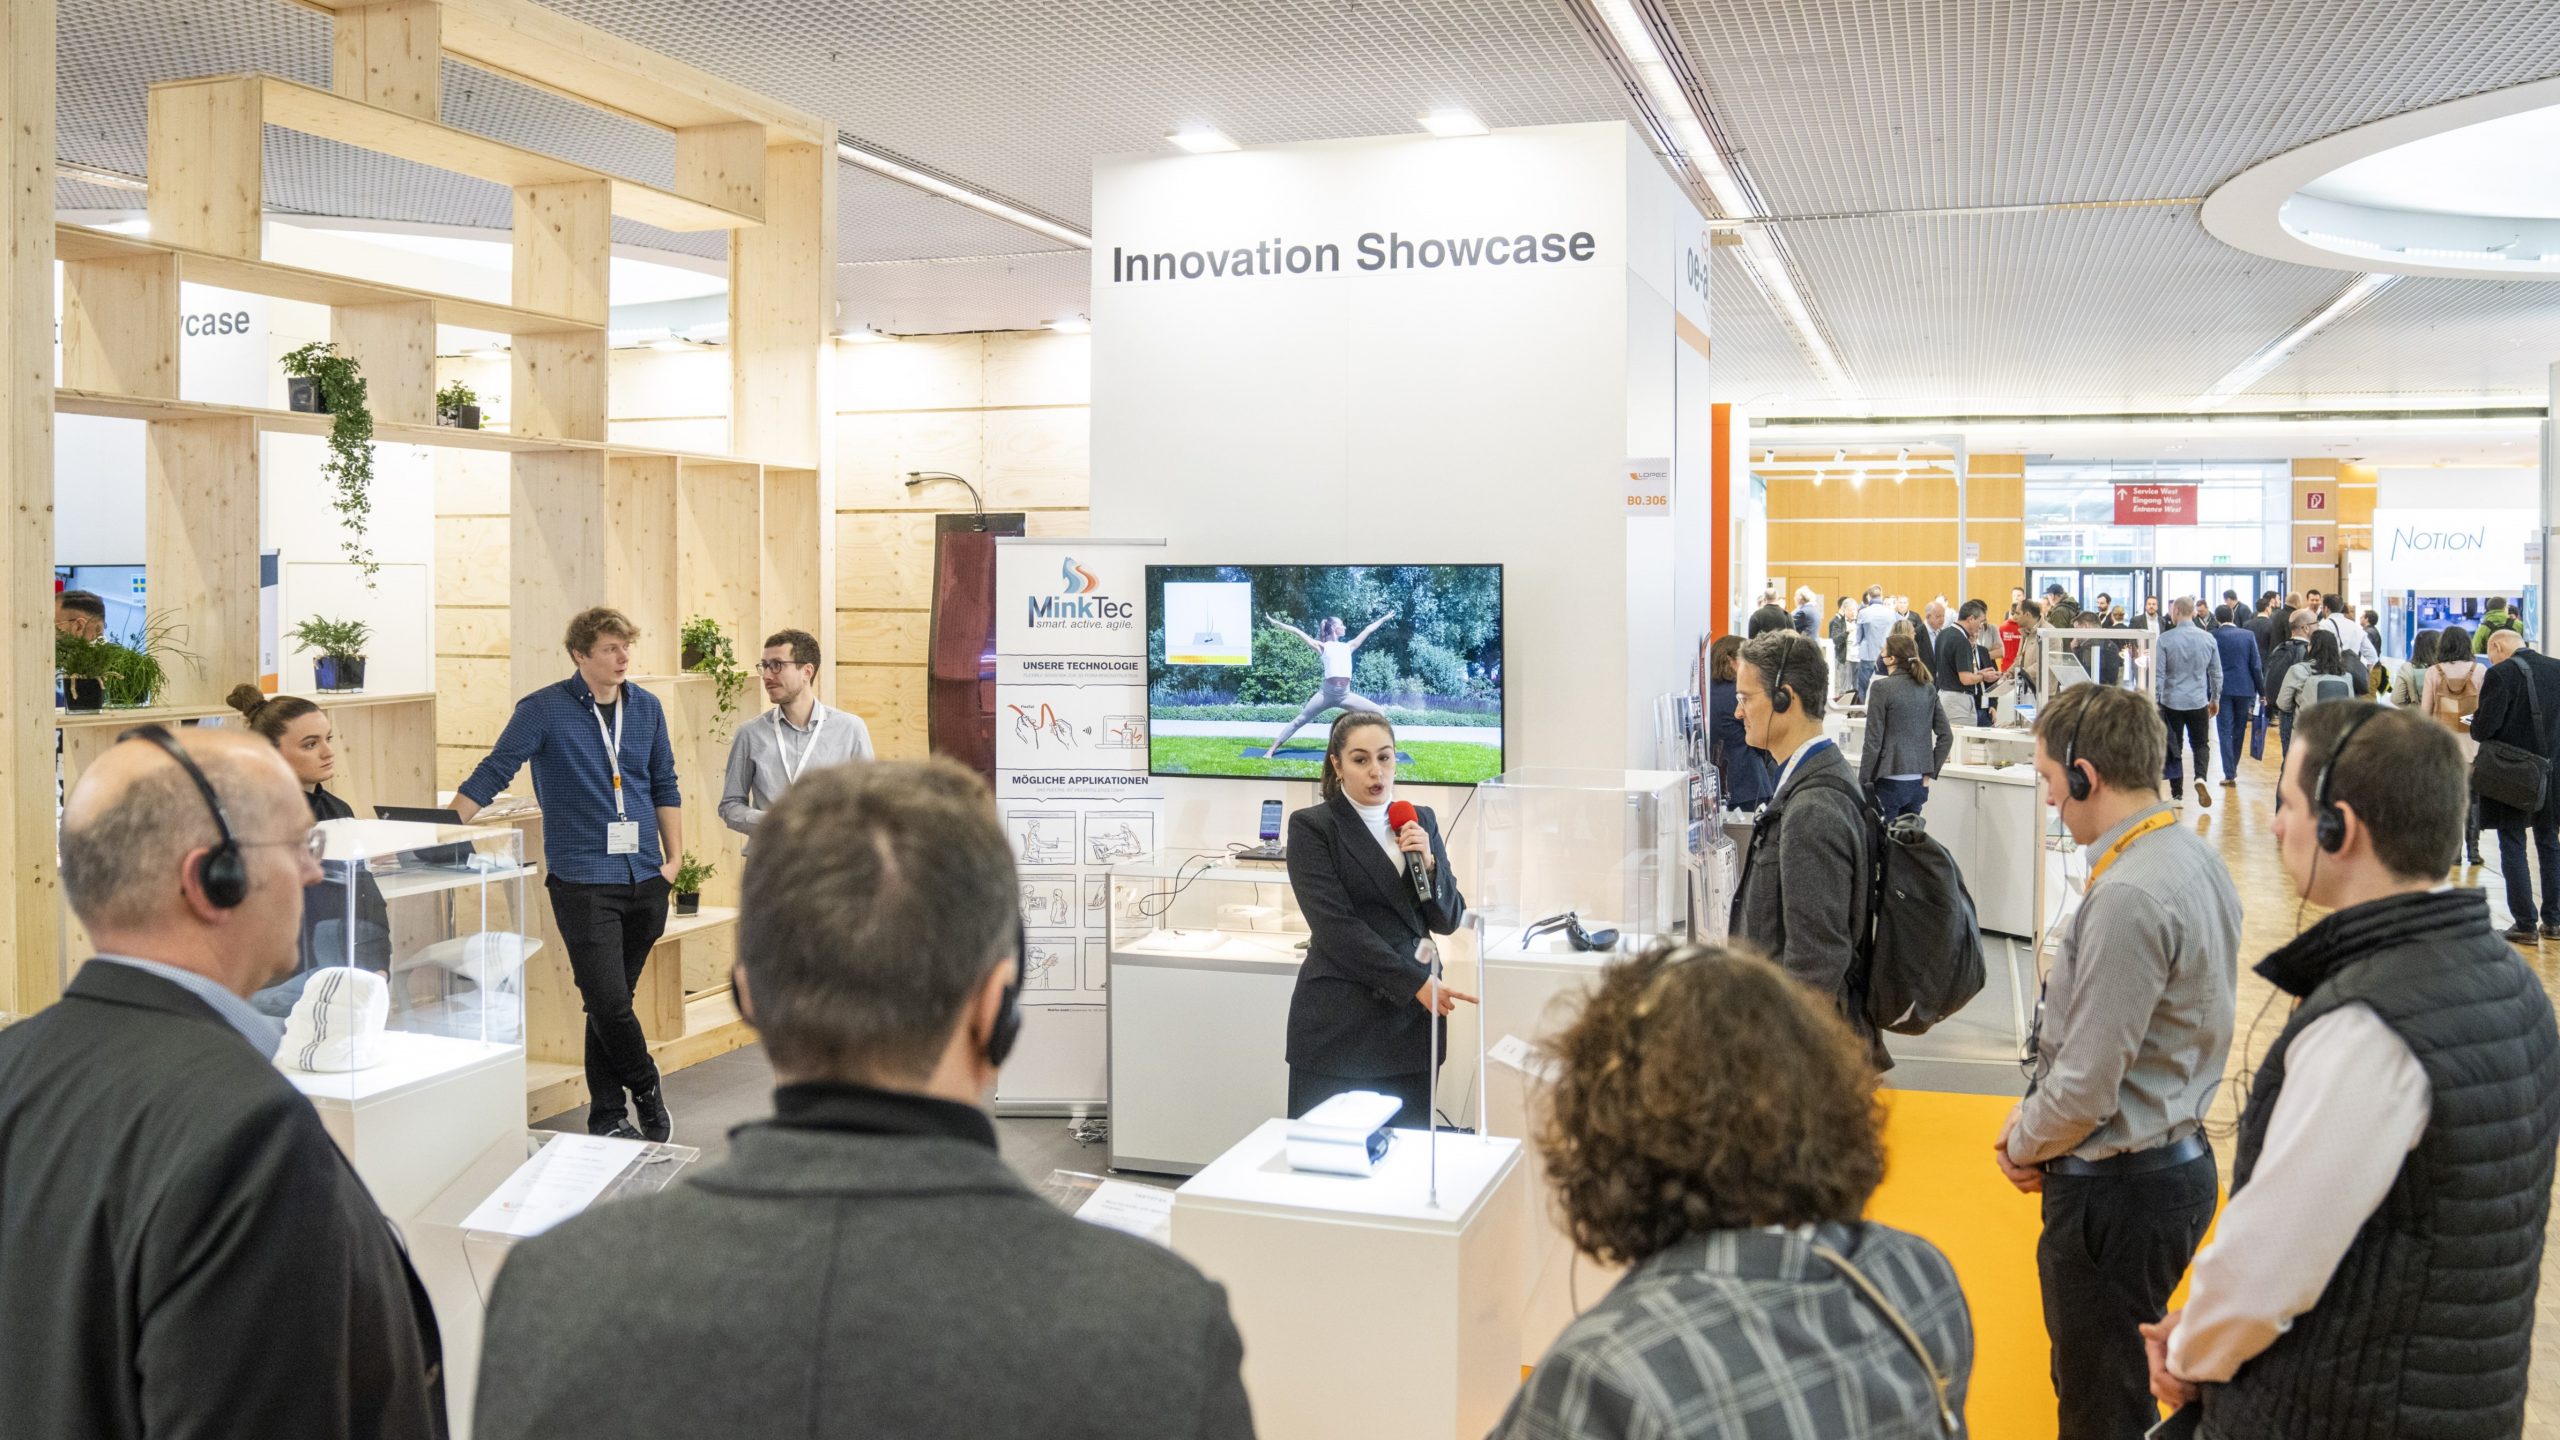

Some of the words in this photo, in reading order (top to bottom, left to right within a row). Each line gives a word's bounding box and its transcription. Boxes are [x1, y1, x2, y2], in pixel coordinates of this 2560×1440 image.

[1113, 237, 1340, 282] Innovation
[1356, 231, 1597, 271] Showcase
[180, 310, 250, 337] case
[2132, 487, 2159, 495] Service
[2160, 487, 2178, 495] West
[1627, 495, 1667, 506] B0.306
[2132, 496, 2162, 505] Eingang
[2163, 496, 2182, 504] West
[2132, 505, 2163, 513] Entrance
[2164, 505, 2182, 513] West
[2391, 525, 2485, 561] NOTION
[1028, 596, 1133, 628] MinkTec
[1036, 620, 1068, 629] smart.
[1070, 620, 1103, 629] active.
[1106, 620, 1134, 631] agile.
[1023, 661, 1065, 670] UNSERE
[1066, 662, 1138, 671] TECHNOLOGIE
[1012, 774, 1066, 785] MÖGLICHE
[1068, 776, 1149, 785] APPLIKATIONEN
